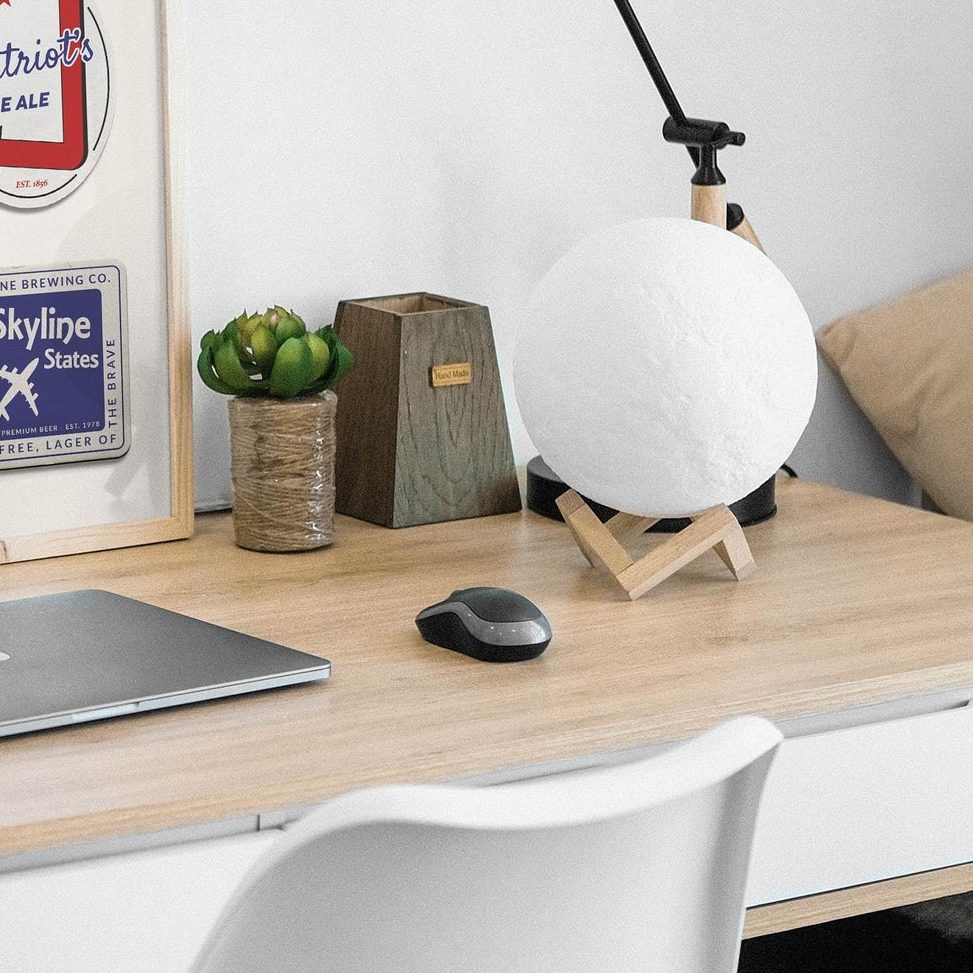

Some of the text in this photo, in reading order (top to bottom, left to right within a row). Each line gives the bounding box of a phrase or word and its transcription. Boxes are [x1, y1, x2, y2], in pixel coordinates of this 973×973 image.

[15, 92, 50, 111] ALE
[16, 179, 48, 188] EST. 1856
[22, 275, 84, 289] BREWING
[89, 273, 110, 283] CO.
[44, 348, 99, 369] States
[106, 339, 117, 428] THE BRAVE
[1, 428, 36, 436] PREMIUM
[0, 442, 39, 455] FREE,
[46, 437, 91, 450] LAGER
[99, 434, 117, 444] OF
